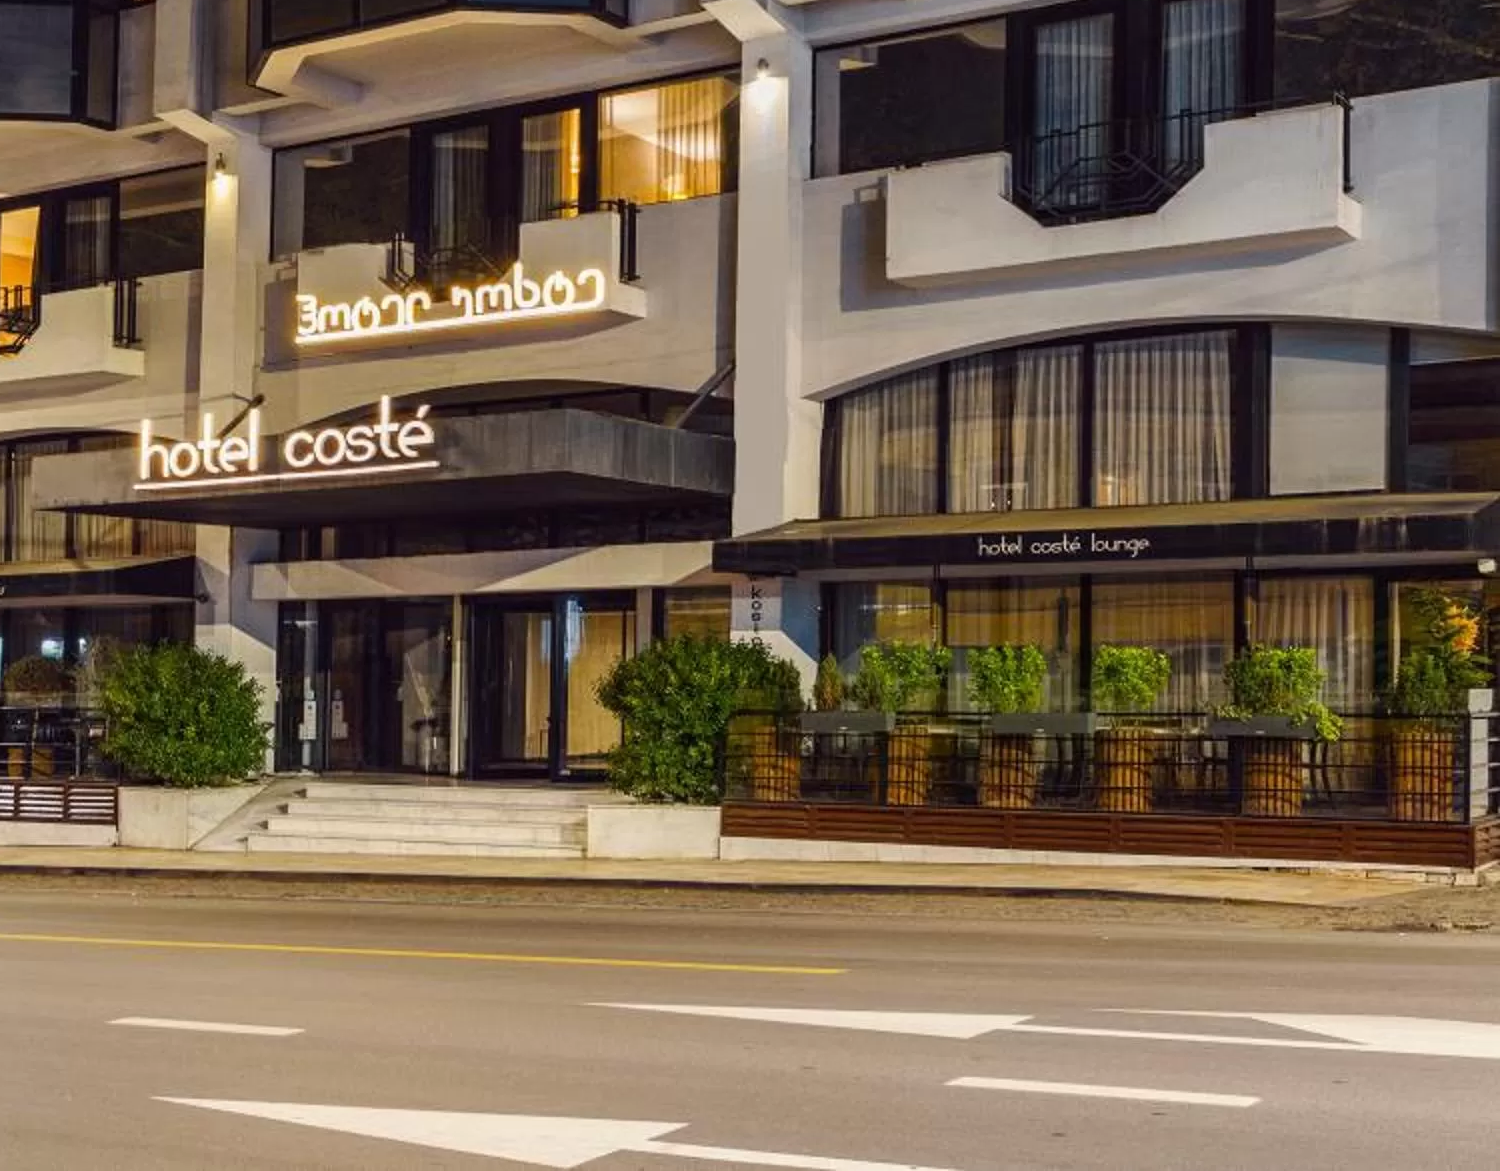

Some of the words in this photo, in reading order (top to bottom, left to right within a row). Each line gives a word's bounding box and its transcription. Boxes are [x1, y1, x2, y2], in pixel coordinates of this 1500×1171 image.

[140, 409, 261, 480] hotel
[284, 394, 435, 467] costé
[978, 535, 1023, 557] hotel
[1030, 533, 1082, 555] costé
[1091, 532, 1150, 558] lounge
